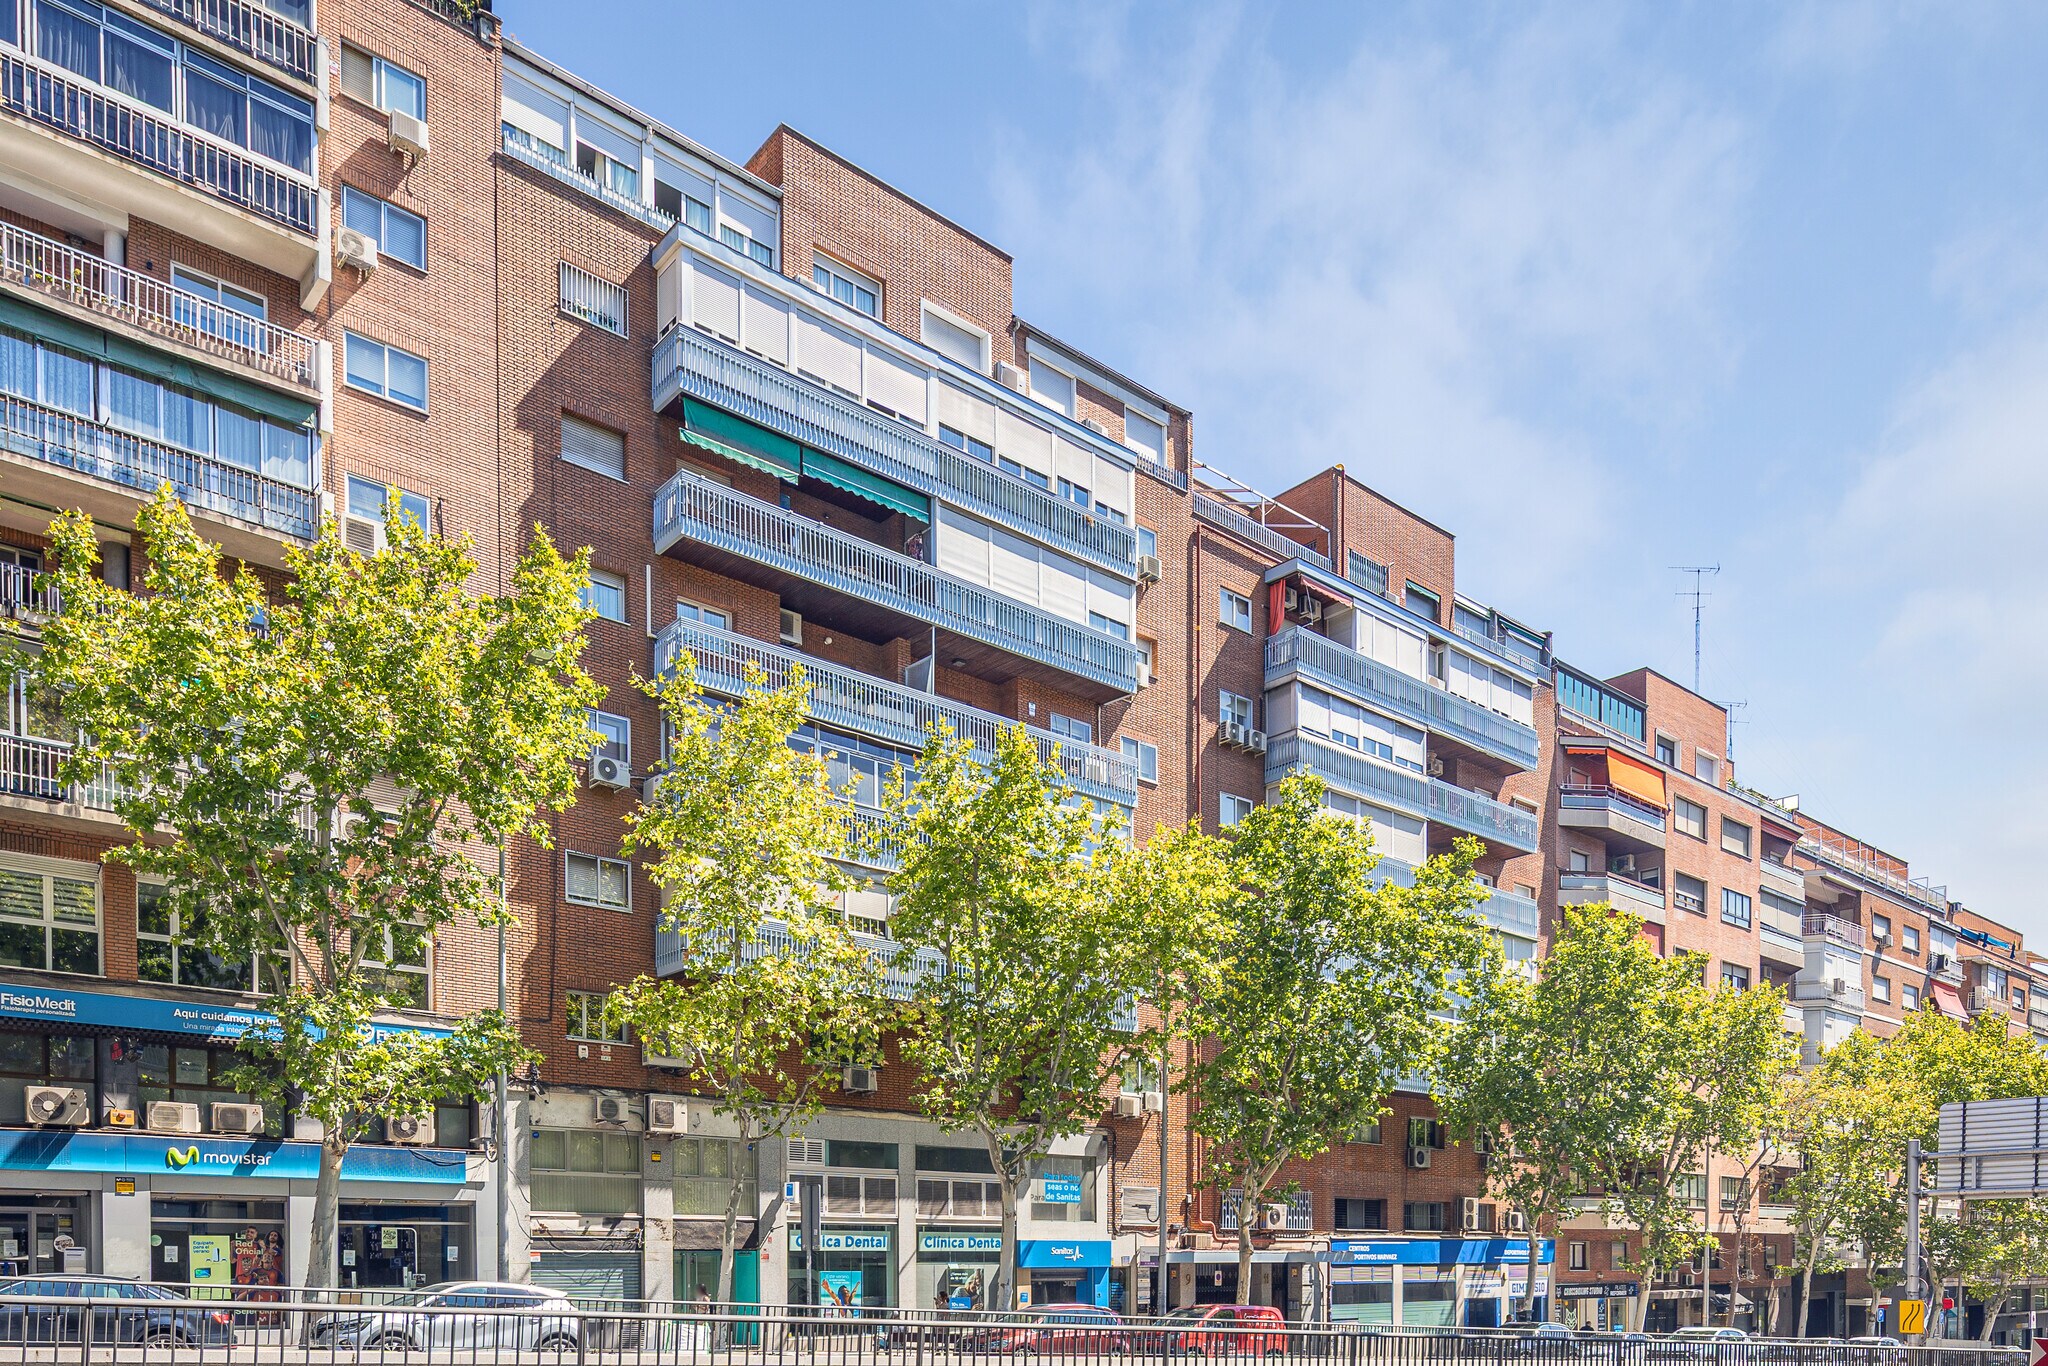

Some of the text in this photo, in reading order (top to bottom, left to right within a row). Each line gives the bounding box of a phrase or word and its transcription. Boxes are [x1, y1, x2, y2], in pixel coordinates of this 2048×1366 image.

[1, 1005, 76, 1017] Fisioterapia personalizada
[174, 1008, 198, 1019] Aquí
[201, 1011, 252, 1024] cuidamos
[254, 1016, 264, 1025] lo
[183, 1022, 198, 1030] Una
[200, 1024, 224, 1033] mirada
[203, 1152, 272, 1166] movistar
[1044, 1172, 1080, 1182] Para todos
[1047, 1183, 1062, 1191] seas
[1046, 1192, 1080, 1201] de Sanitas
[235, 1232, 246, 1240] La
[796, 1234, 887, 1248] Cica Dental
[235, 1240, 253, 1248] Red
[924, 1235, 1003, 1249] Clínica Denta
[1051, 1247, 1074, 1255] Sanitas
[1353, 1253, 1377, 1261] PORTIVOS
[1511, 1282, 1546, 1293] GIMSIO
